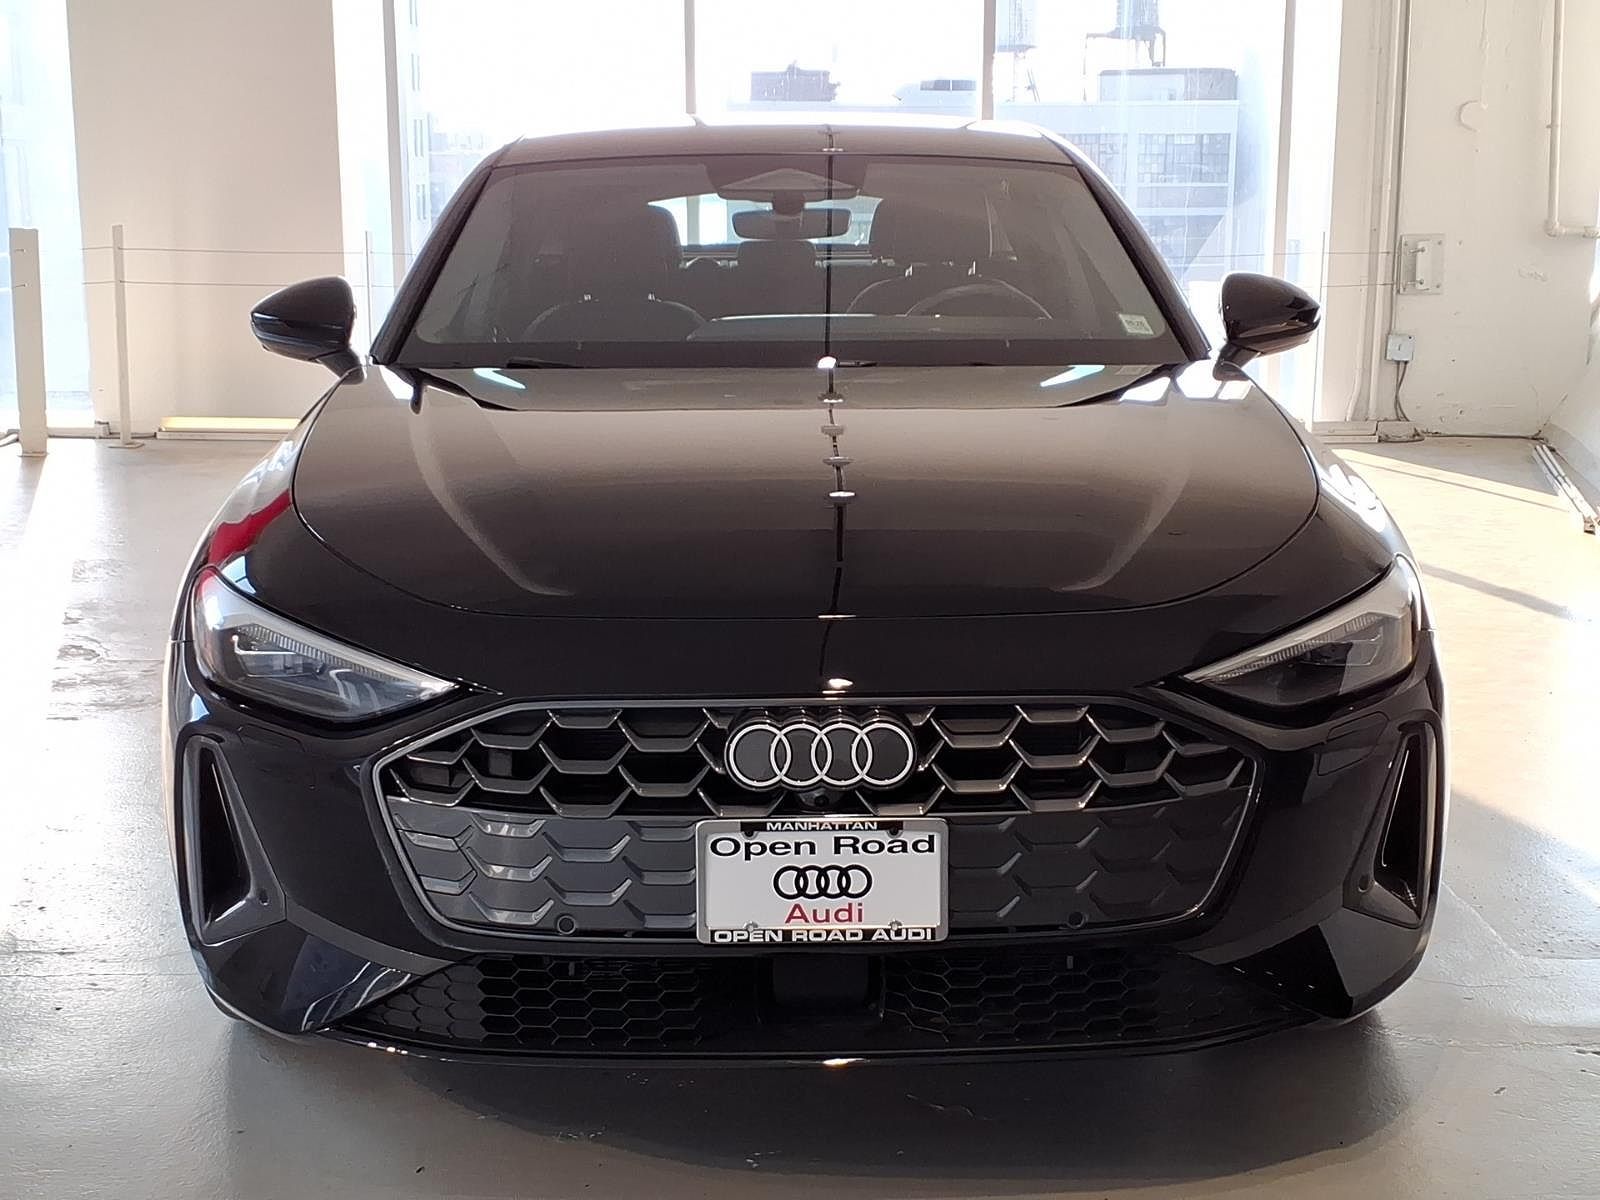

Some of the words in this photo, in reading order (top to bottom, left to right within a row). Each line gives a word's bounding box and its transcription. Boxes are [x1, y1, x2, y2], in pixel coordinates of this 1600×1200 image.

[766, 821, 878, 831] MANHATTAN
[710, 837, 816, 861] Open
[833, 835, 935, 855] Road
[785, 902, 863, 924] Audi
[714, 929, 783, 943] OPEN
[792, 928, 863, 942] ROAD
[871, 928, 932, 941] AUDI
